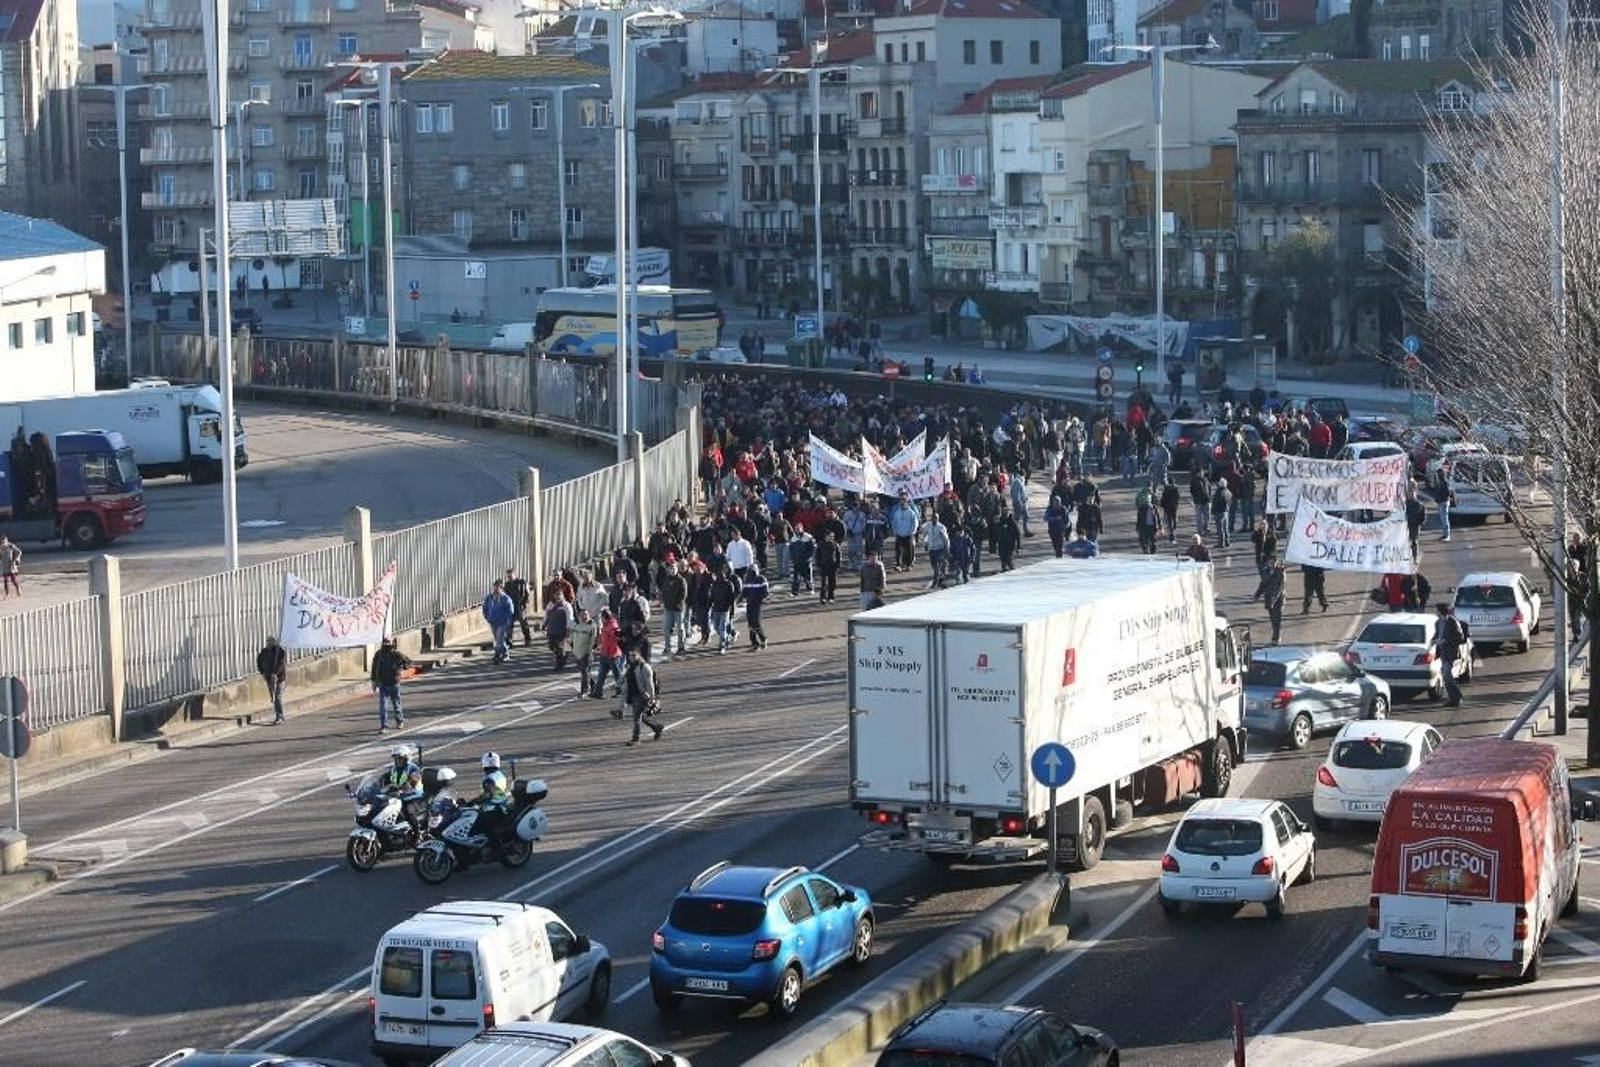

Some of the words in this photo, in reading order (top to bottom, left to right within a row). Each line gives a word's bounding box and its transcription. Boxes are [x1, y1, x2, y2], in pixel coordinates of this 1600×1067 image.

[1274, 455, 1361, 479] QUEREMOS
[1275, 485, 1288, 509] E
[1301, 483, 1339, 506] NON
[1309, 541, 1364, 563] DALLE
[858, 658, 882, 671] Ship
[885, 660, 923, 674] Supply
[1411, 810, 1429, 820] LA
[1435, 811, 1493, 824] CALIDAD
[1411, 849, 1488, 879] DULCESOL
